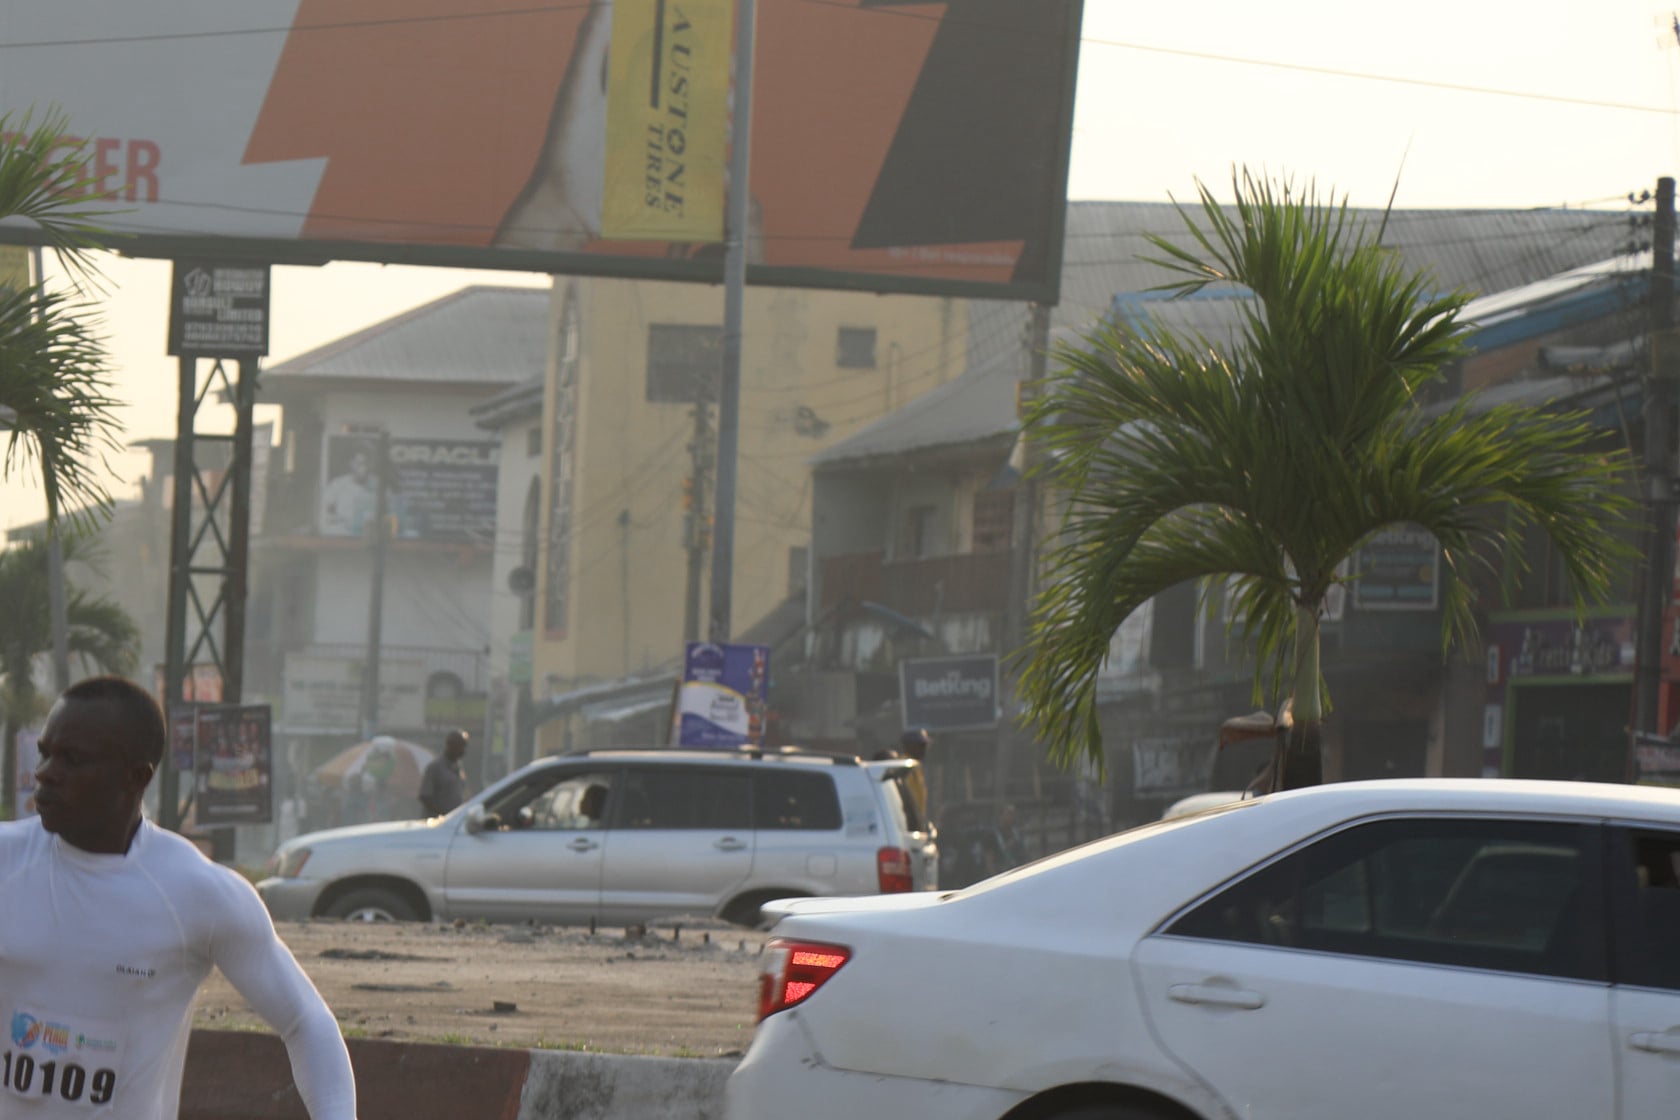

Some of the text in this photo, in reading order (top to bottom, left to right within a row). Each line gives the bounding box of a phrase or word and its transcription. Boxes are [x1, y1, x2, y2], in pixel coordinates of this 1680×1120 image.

[664, 5, 692, 219] AUSTONE
[645, 122, 665, 208] TIRES
[2, 1050, 117, 1107] 10109
